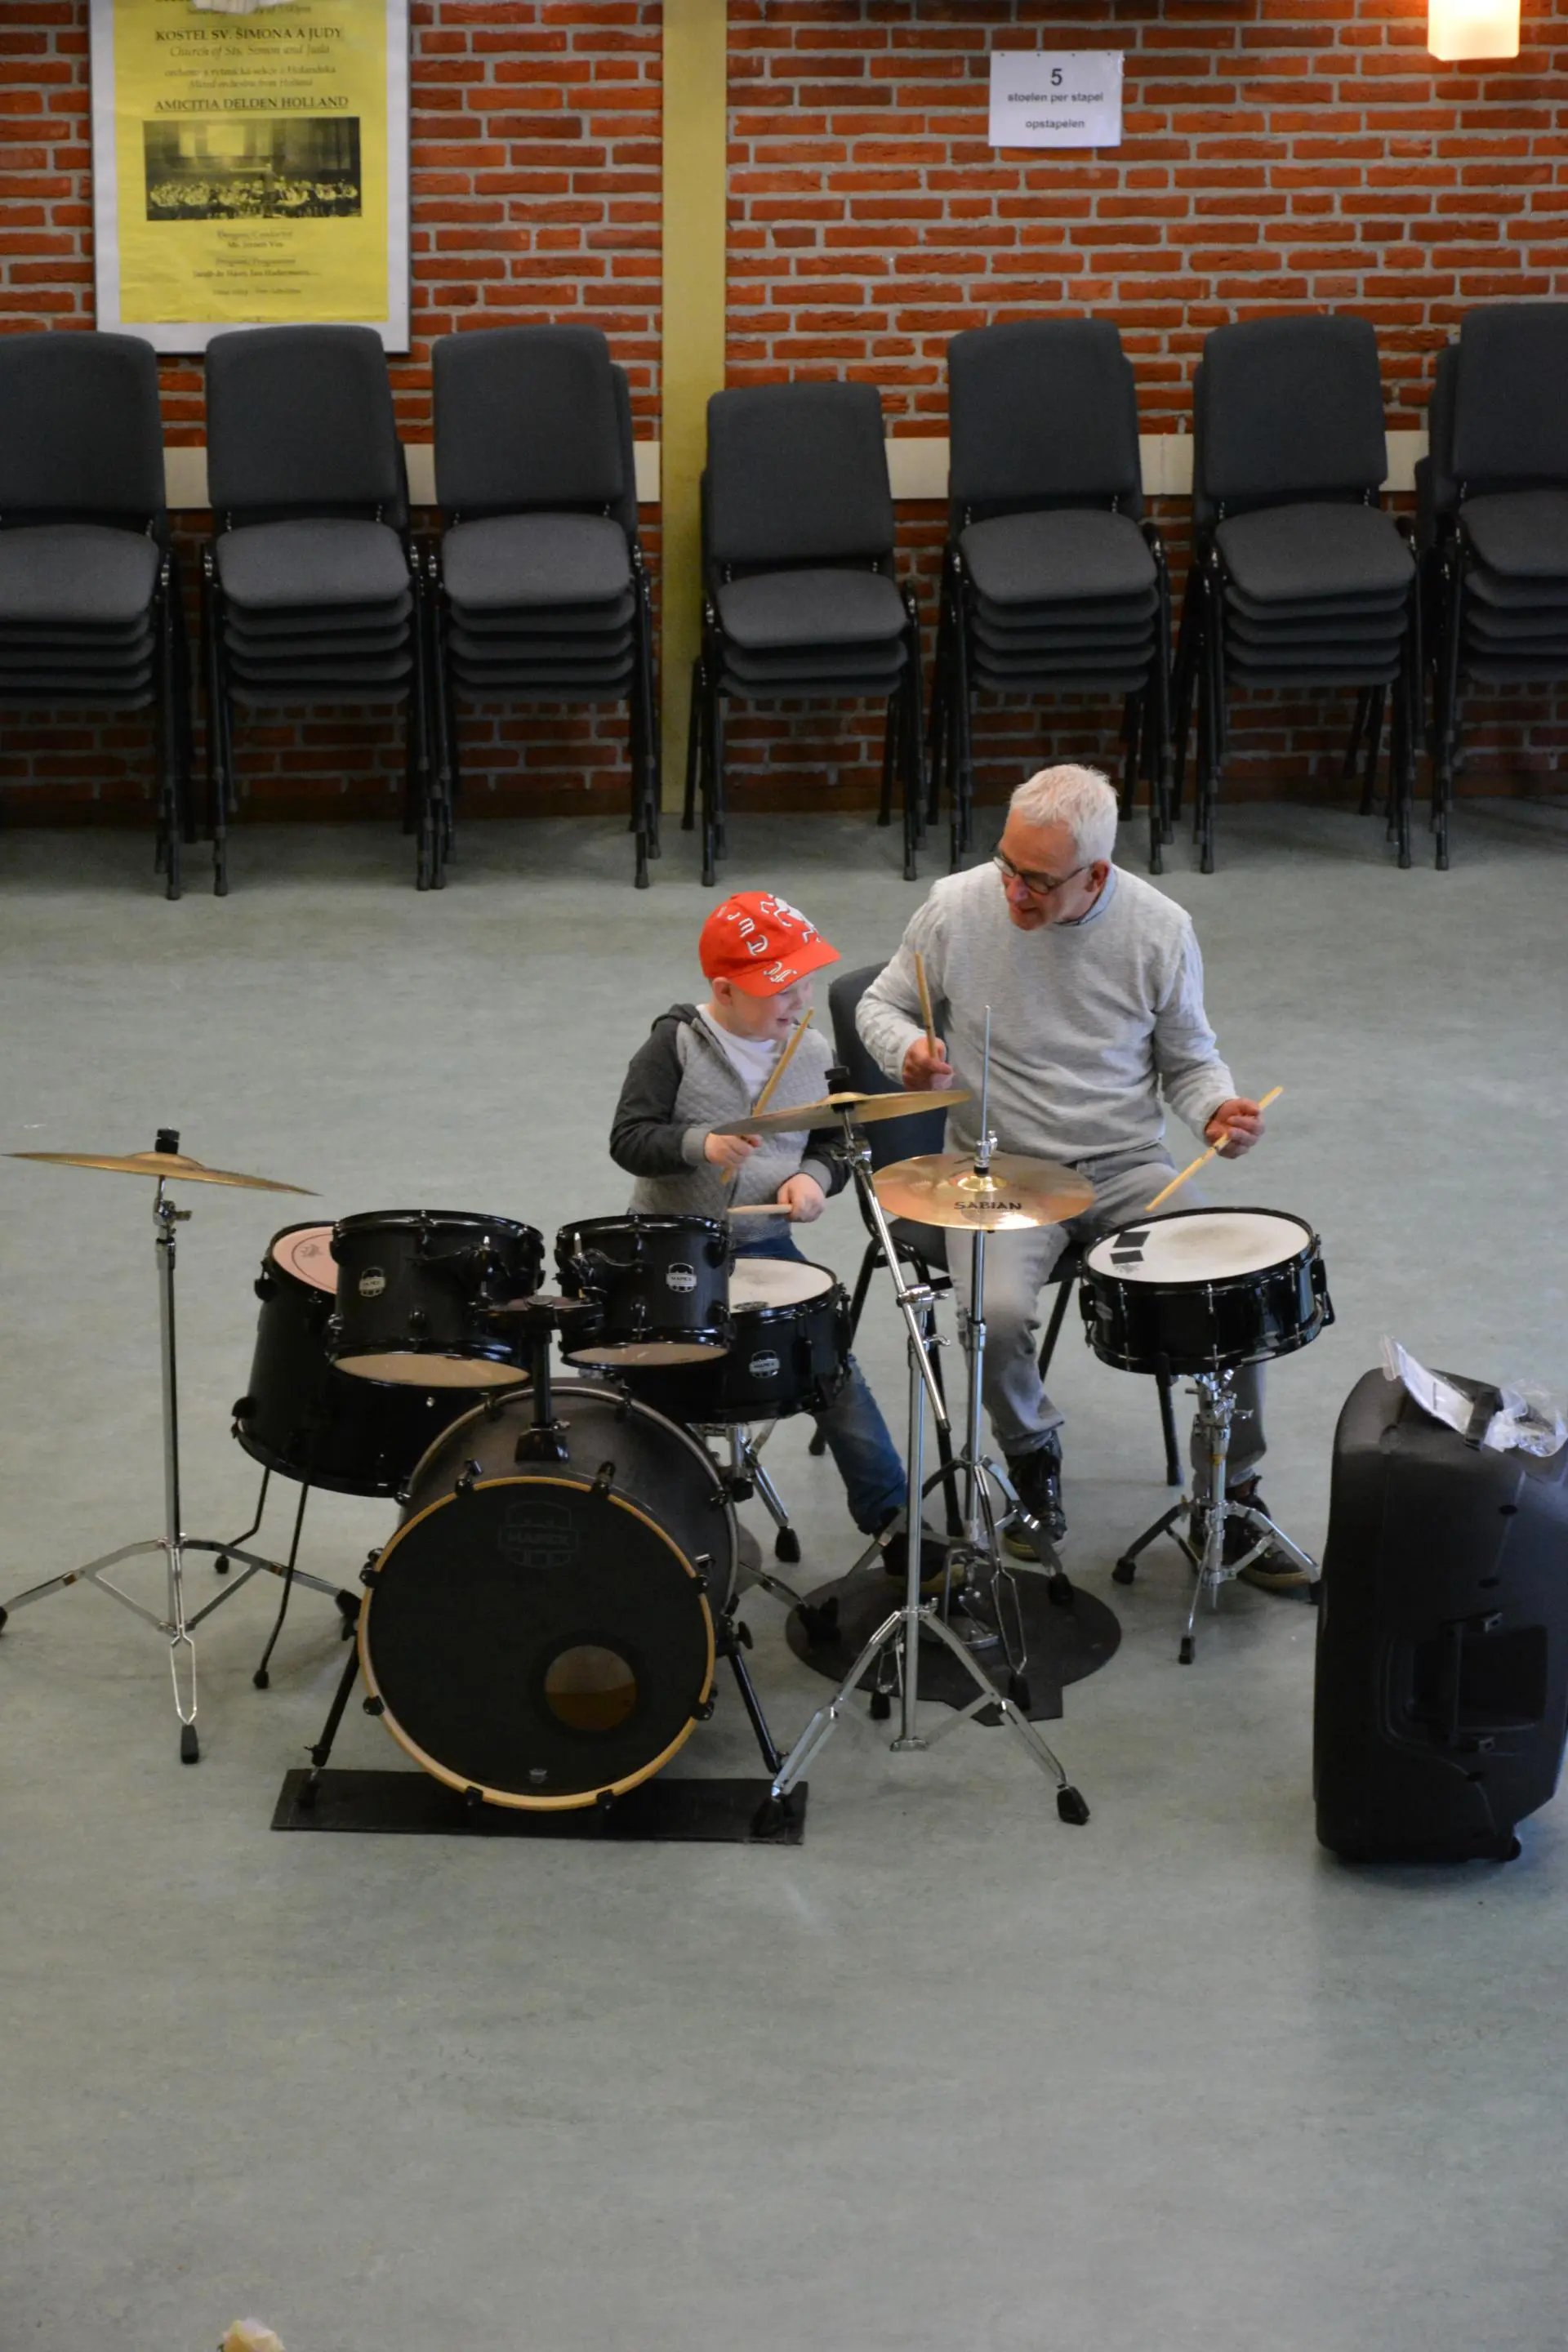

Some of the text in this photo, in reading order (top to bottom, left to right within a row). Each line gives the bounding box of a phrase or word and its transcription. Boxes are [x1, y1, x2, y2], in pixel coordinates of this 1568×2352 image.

[155, 29, 207, 41] KOSTEL
[212, 29, 232, 40] SV.
[296, 28, 305, 38] A
[308, 27, 342, 41] JUDY
[1051, 69, 1063, 86] 5
[224, 97, 277, 109] DELDEN
[282, 96, 349, 108] HOLLAND
[1007, 91, 1104, 104] stoelen per stapel
[1025, 118, 1085, 130] opstapelen
[954, 1201, 1022, 1210] SABIAN
